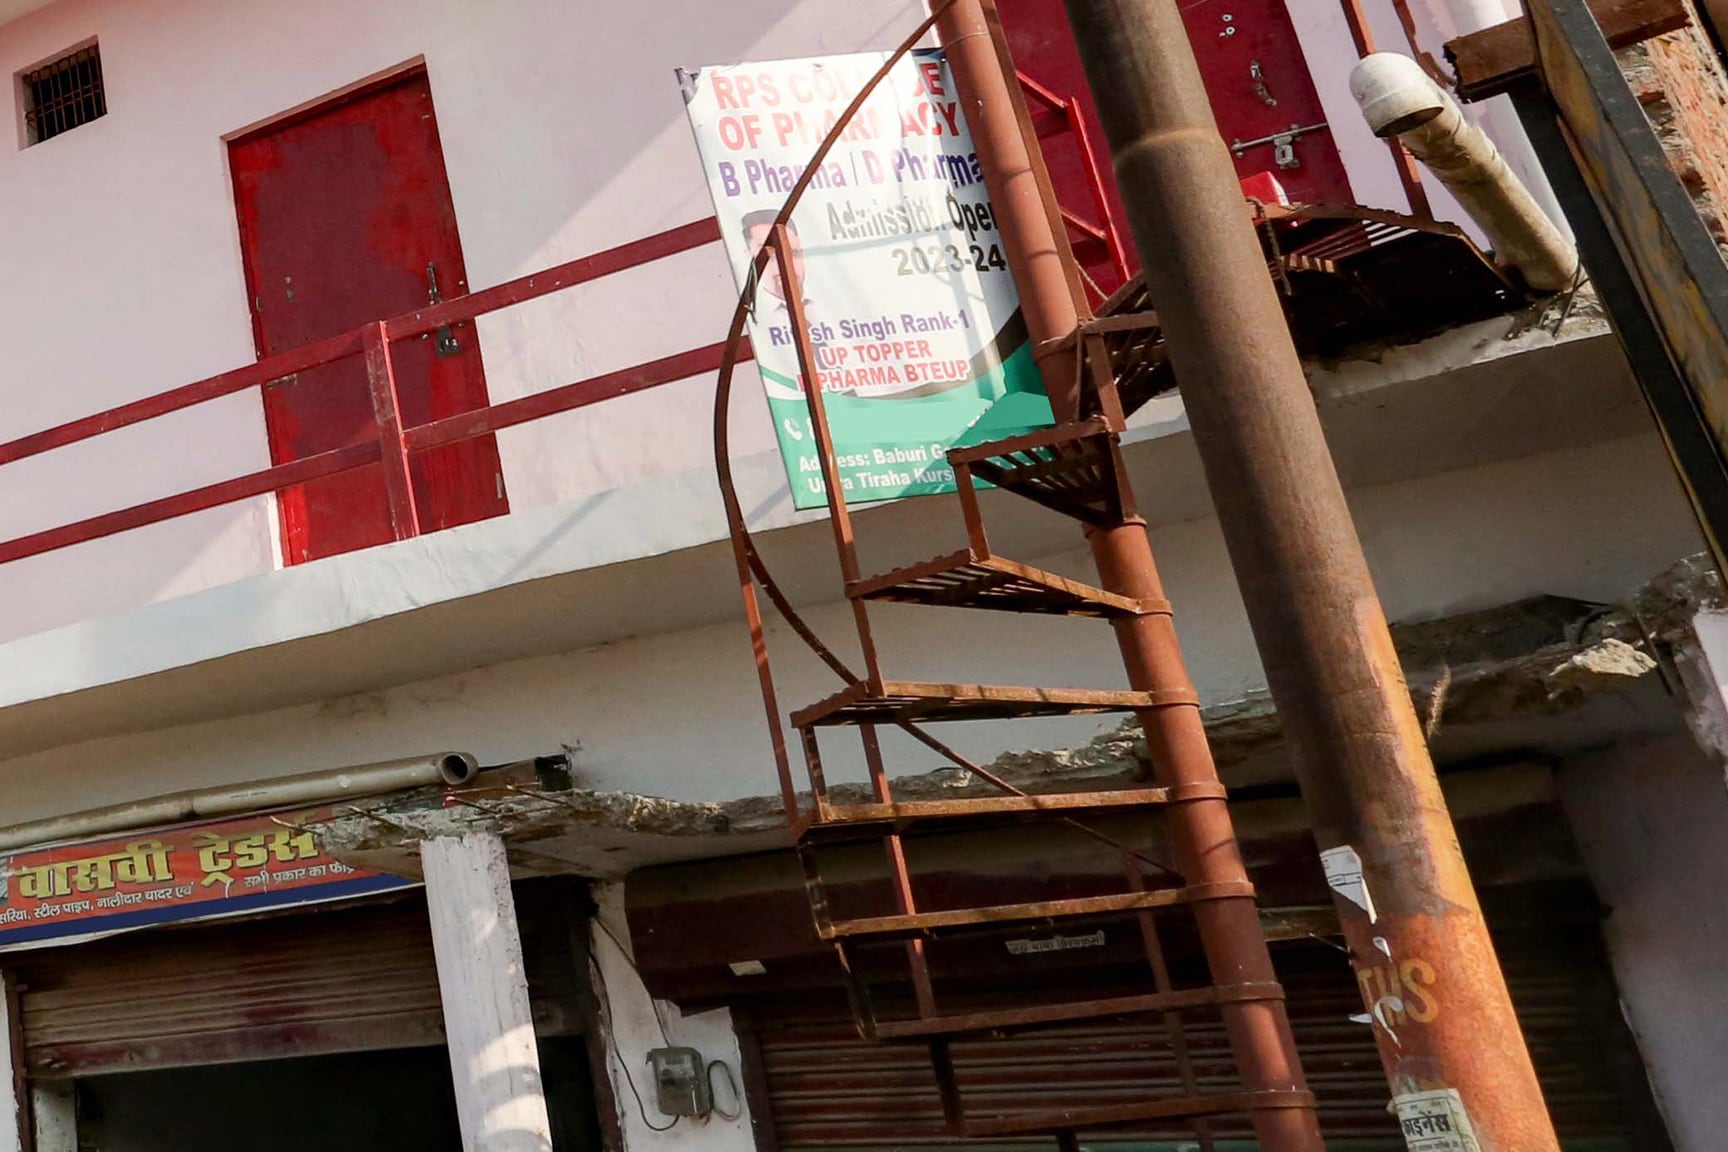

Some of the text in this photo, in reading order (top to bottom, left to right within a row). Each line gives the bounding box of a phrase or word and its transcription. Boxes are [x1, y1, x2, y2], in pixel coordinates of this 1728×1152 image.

[710, 62, 946, 111] RPS COLE
[718, 102, 960, 151] OF PHARACY
[718, 161, 741, 198] B
[861, 149, 885, 184] D
[827, 196, 945, 241] Admissio
[891, 243, 1006, 277] 2023-24
[769, 308, 971, 347] Rish Singh Rank-1
[823, 339, 933, 368] UP TOPPER
[905, 359, 970, 383] BTEUP
[799, 449, 871, 473] Adess:
[873, 446, 928, 466] Baburi
[856, 470, 912, 490] Tiraha
[12, 839, 177, 902] वासवी
[243, 870, 270, 888] सभी
[272, 866, 308, 883] प्रकार
[308, 863, 327, 877] का
